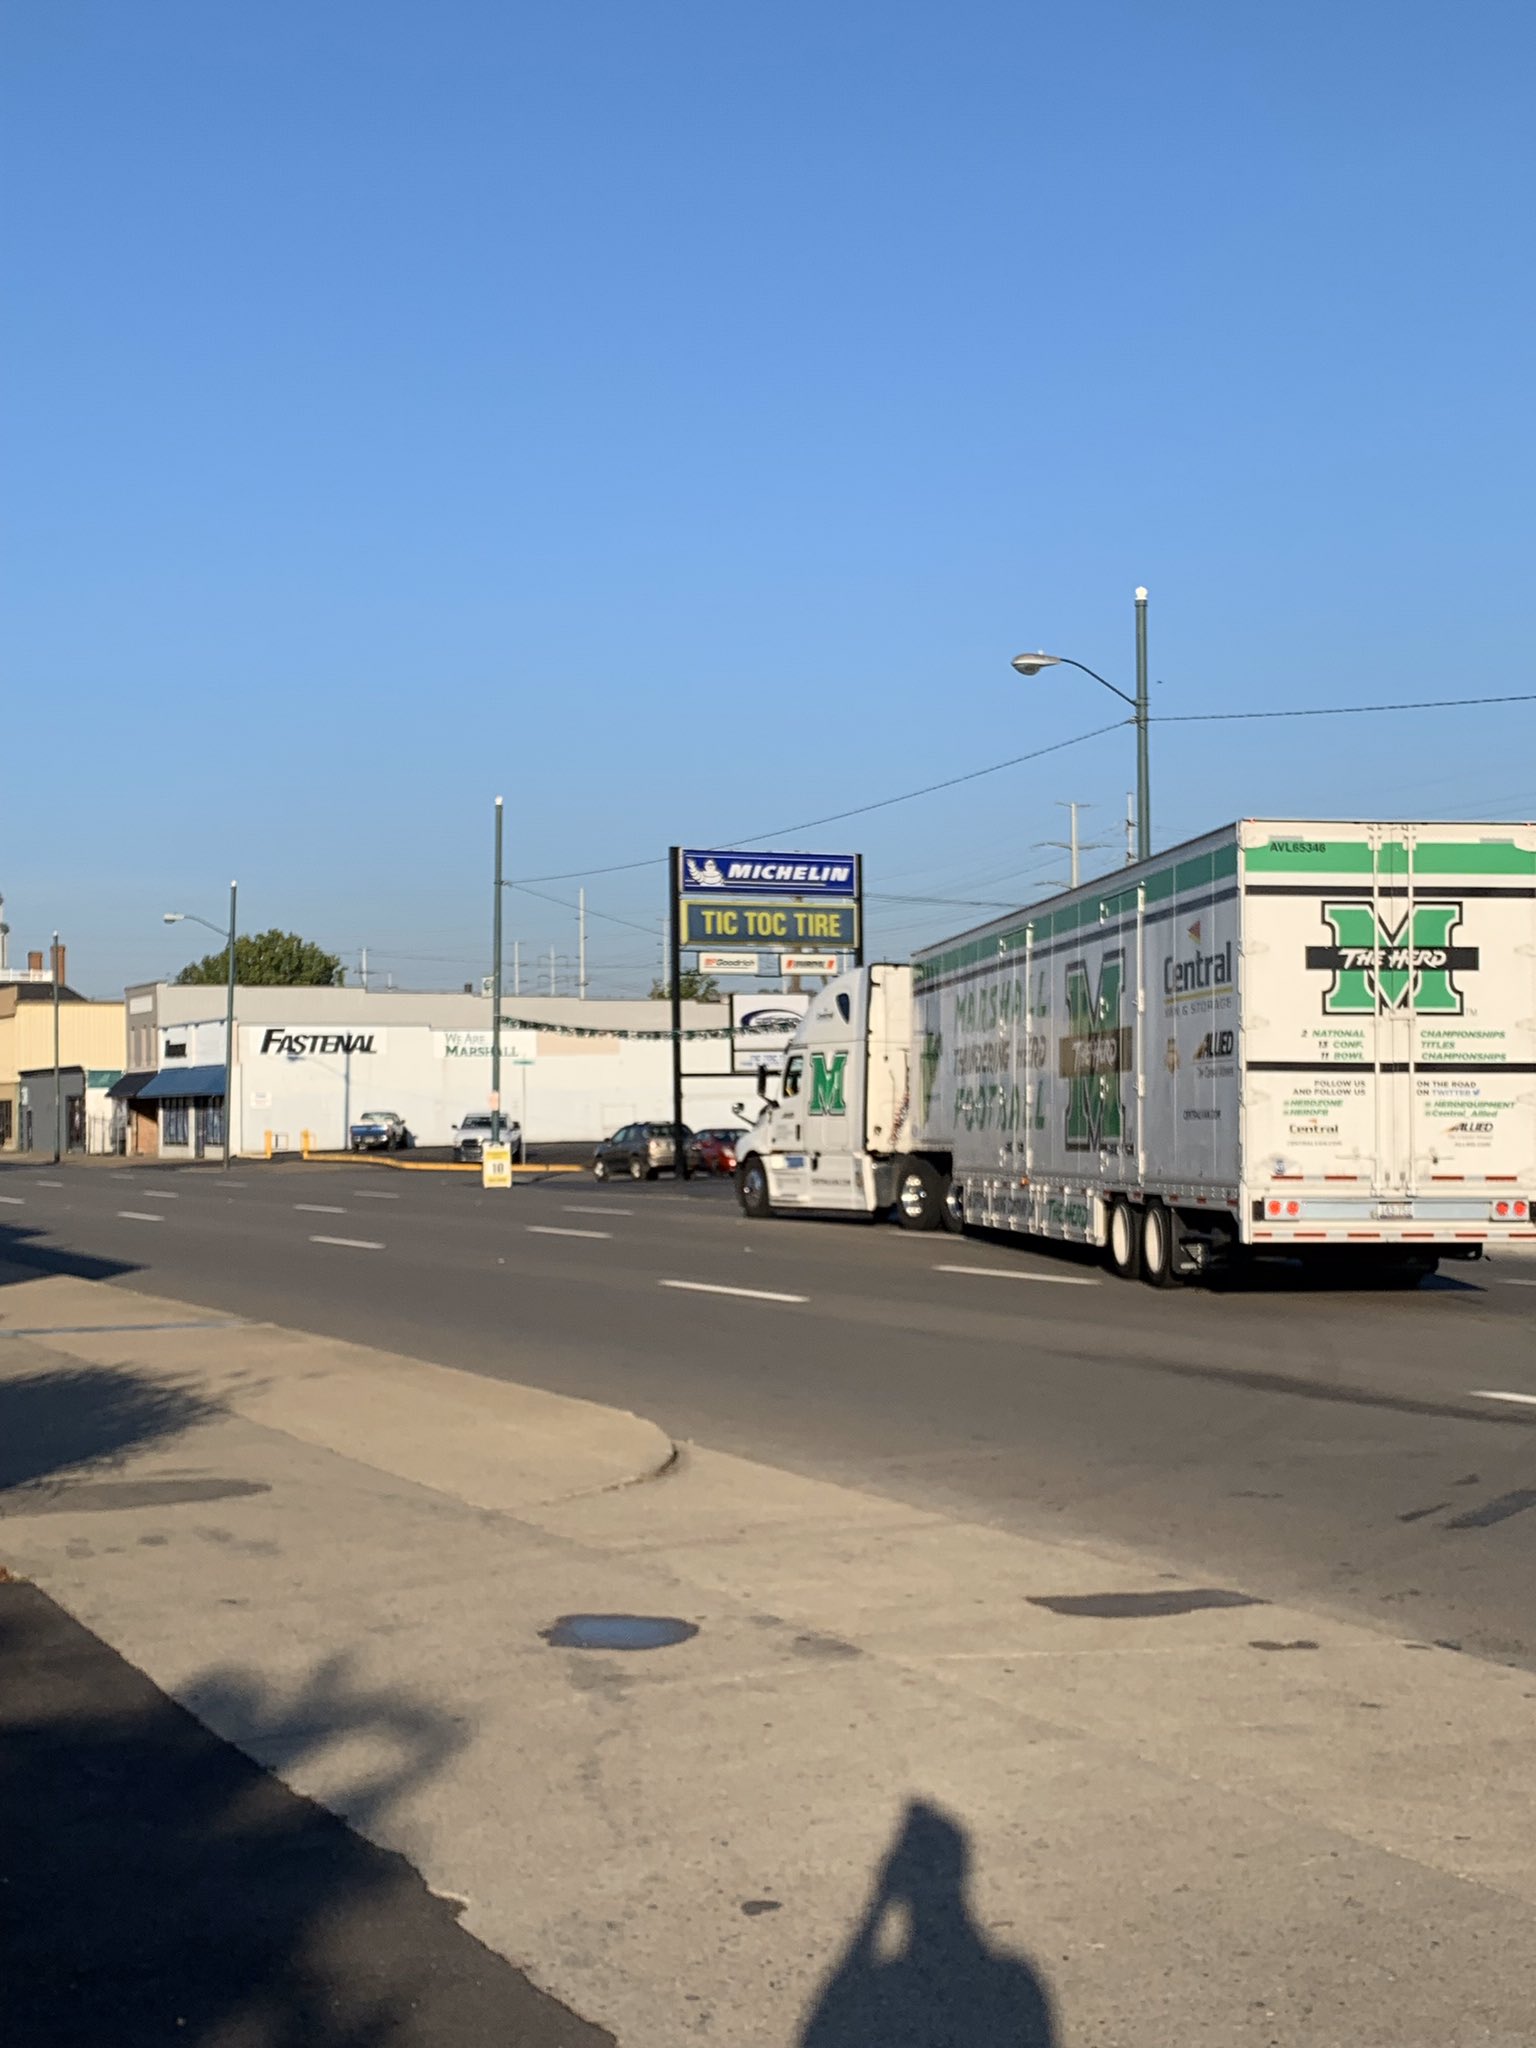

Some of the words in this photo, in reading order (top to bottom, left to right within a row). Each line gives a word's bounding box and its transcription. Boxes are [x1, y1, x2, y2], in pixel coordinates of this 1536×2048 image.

[728, 863, 850, 882] MICHELIN
[701, 911, 738, 935] TIC
[744, 911, 787, 936] TOC
[794, 913, 842, 938] TIRE
[1338, 948, 1386, 970] THE
[1388, 948, 1448, 970] HERD
[1164, 941, 1232, 995] Central
[1301, 1029, 1308, 1038] 2
[1312, 1029, 1366, 1038] NATIONAL
[1420, 1030, 1506, 1038] CHAMPIONSHIPS
[260, 1028, 377, 1055] FASTENAL
[1421, 1041, 1456, 1049] TITLES
[445, 1045, 519, 1057] MARSHLL
[1334, 1052, 1365, 1060] BOWL
[1421, 1052, 1507, 1060] CHAMPIONSHIPS
[1314, 1080, 1352, 1088] FOLLOW
[1293, 1088, 1312, 1096] AND
[1314, 1088, 1352, 1096] FOLLOW
[1354, 1088, 1366, 1096] US
[1416, 1089, 1430, 1097] ON
[1289, 1124, 1339, 1134] Central
